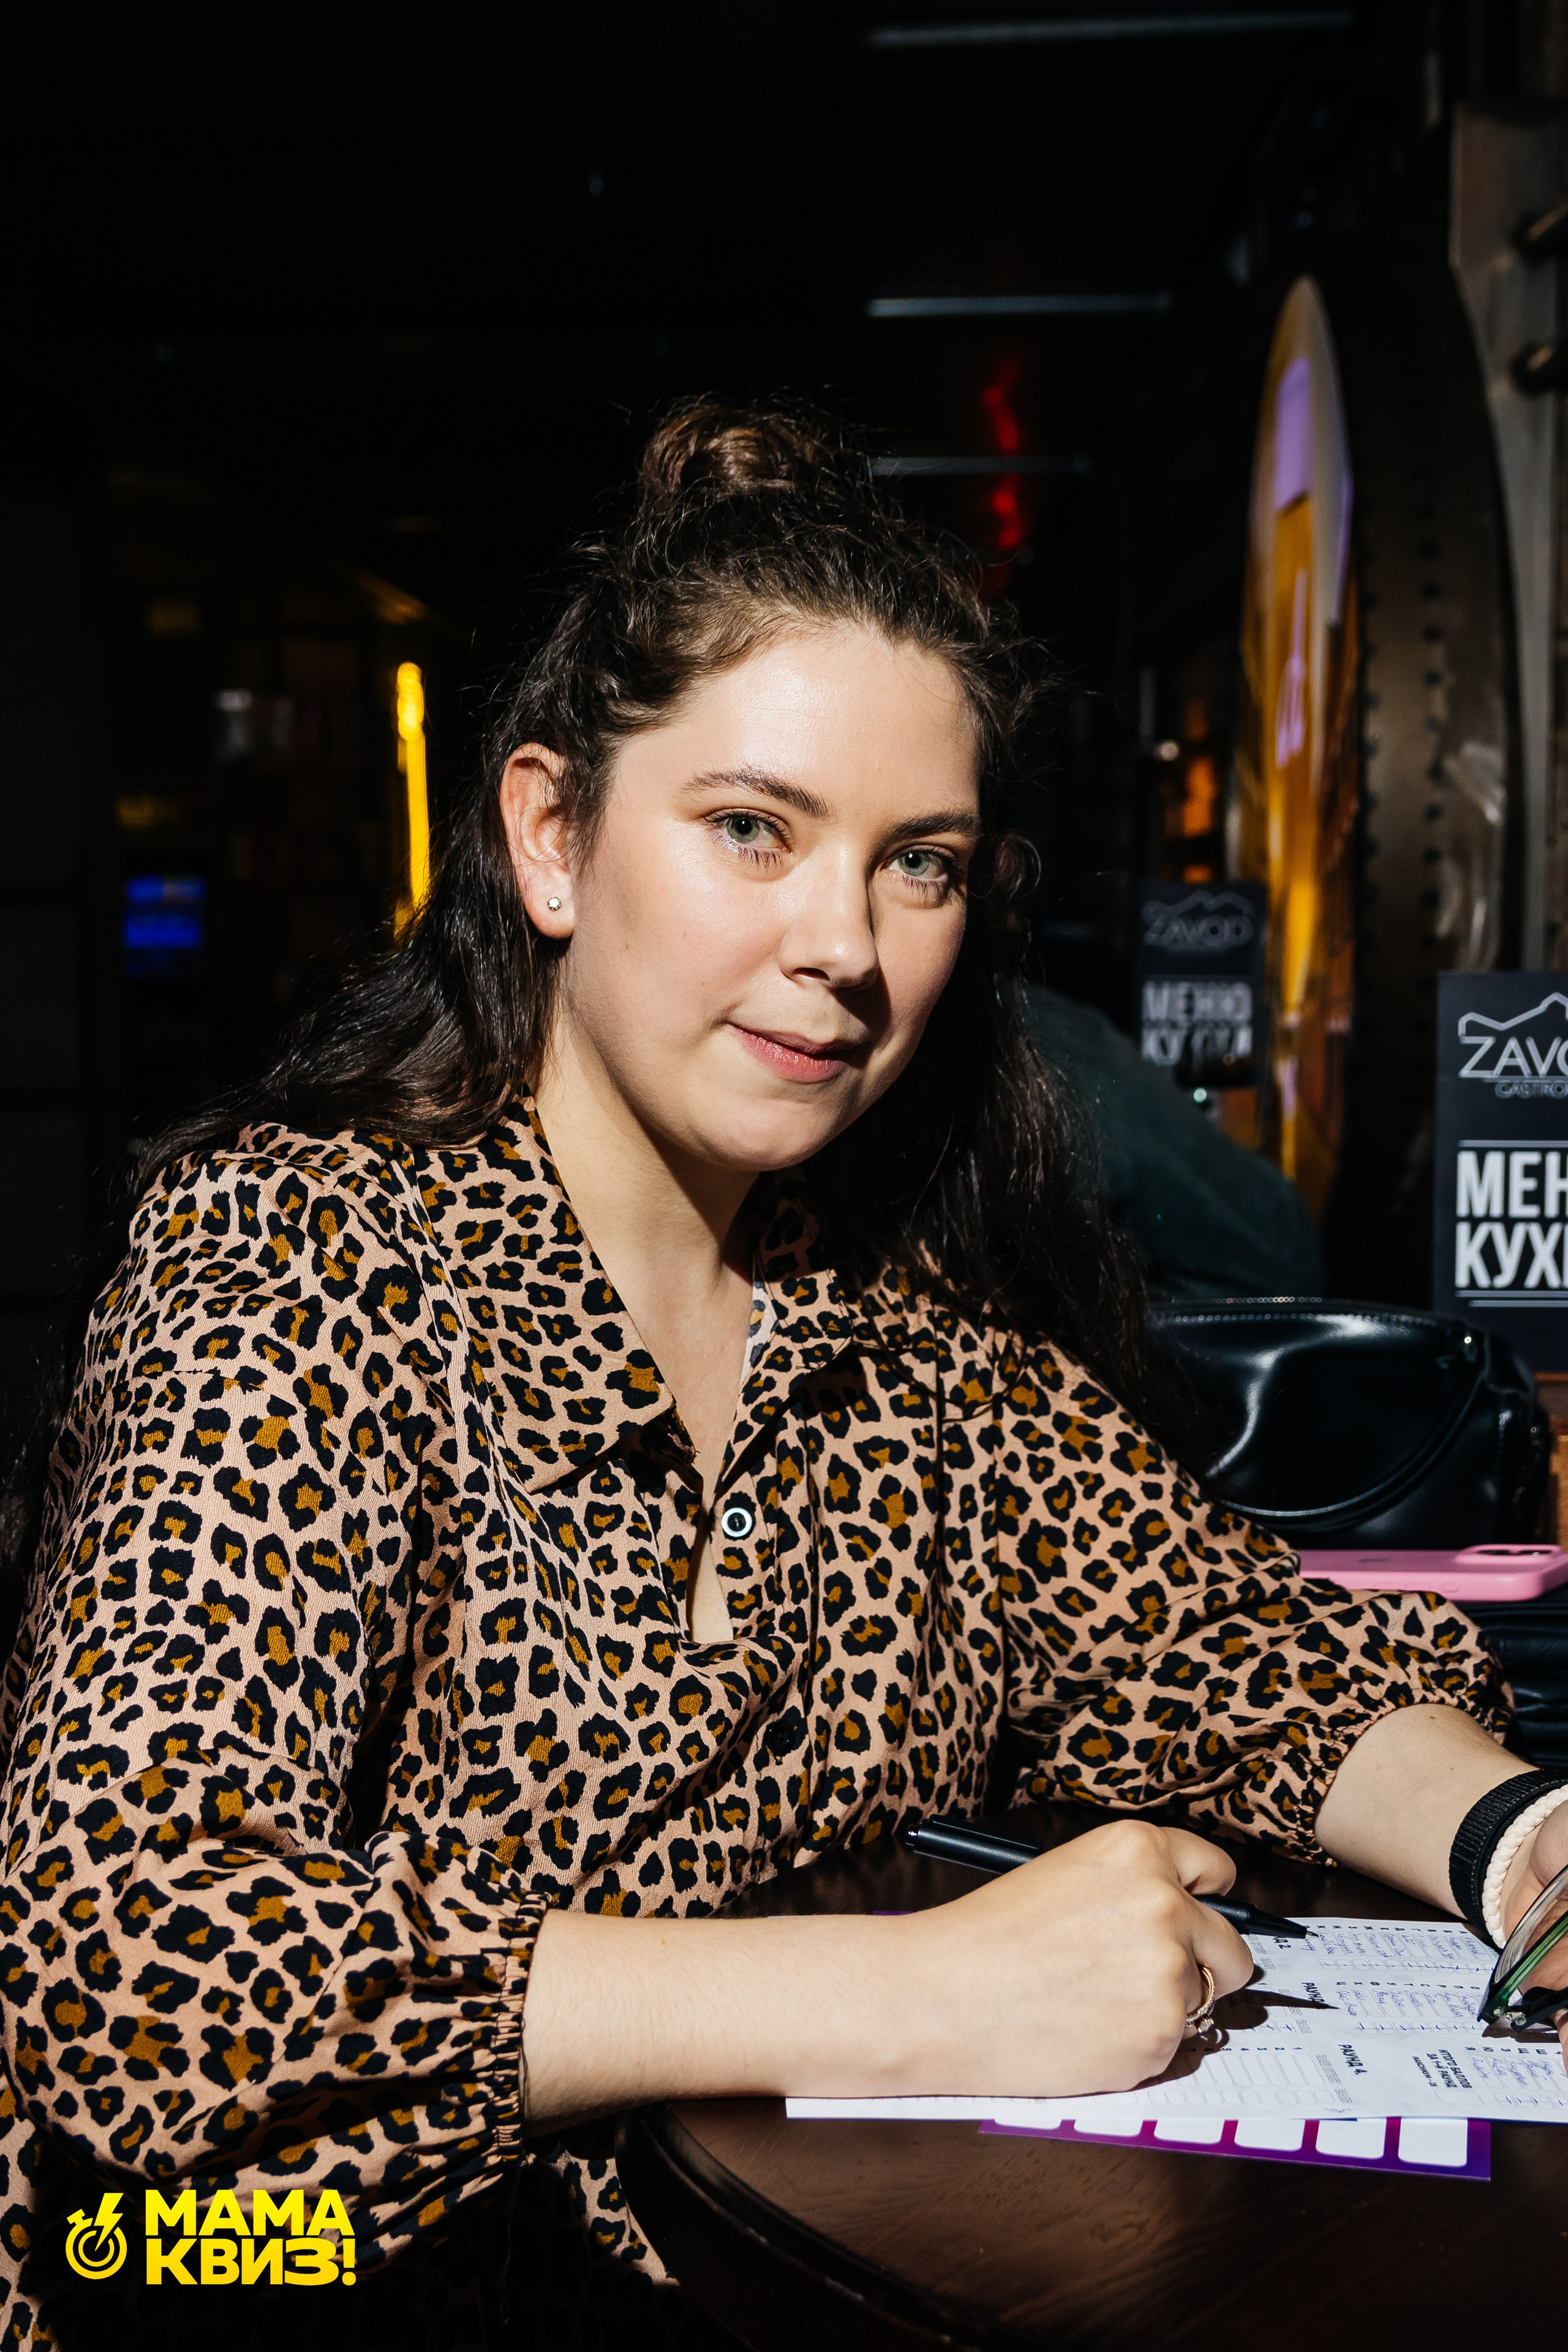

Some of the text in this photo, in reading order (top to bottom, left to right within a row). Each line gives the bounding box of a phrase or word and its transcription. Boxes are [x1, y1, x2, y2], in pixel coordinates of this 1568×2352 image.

[1459, 1036, 1568, 1077] ZAV
[1455, 1221, 1568, 1288] КУХ
[1338, 2045, 1363, 2067] РАУНД
[1438, 2049, 1472, 2088] ИТОГО БАЛЛОВ
[1438, 2070, 1458, 2087] РАУНД
